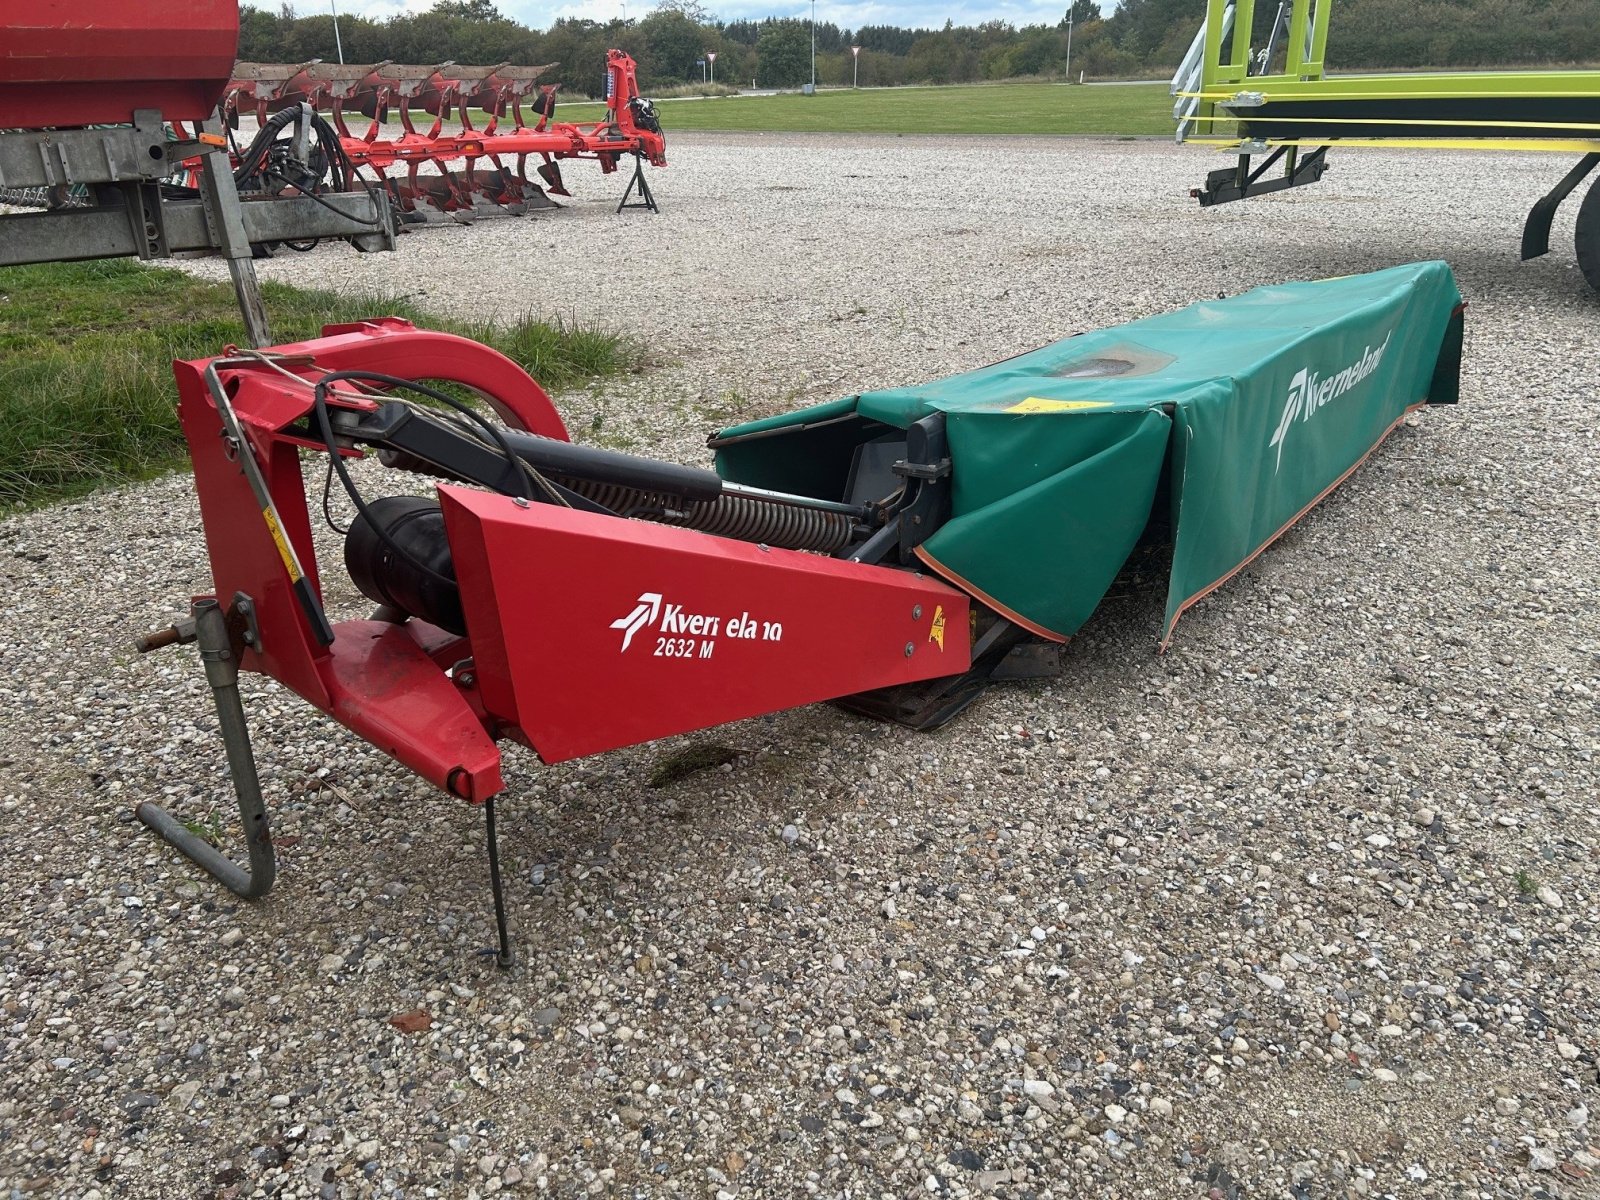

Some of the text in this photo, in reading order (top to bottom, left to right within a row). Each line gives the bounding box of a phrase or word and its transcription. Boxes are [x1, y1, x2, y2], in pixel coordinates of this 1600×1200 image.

[1303, 329, 1392, 423] Kverneland
[653, 637, 715, 659] 2632 M
